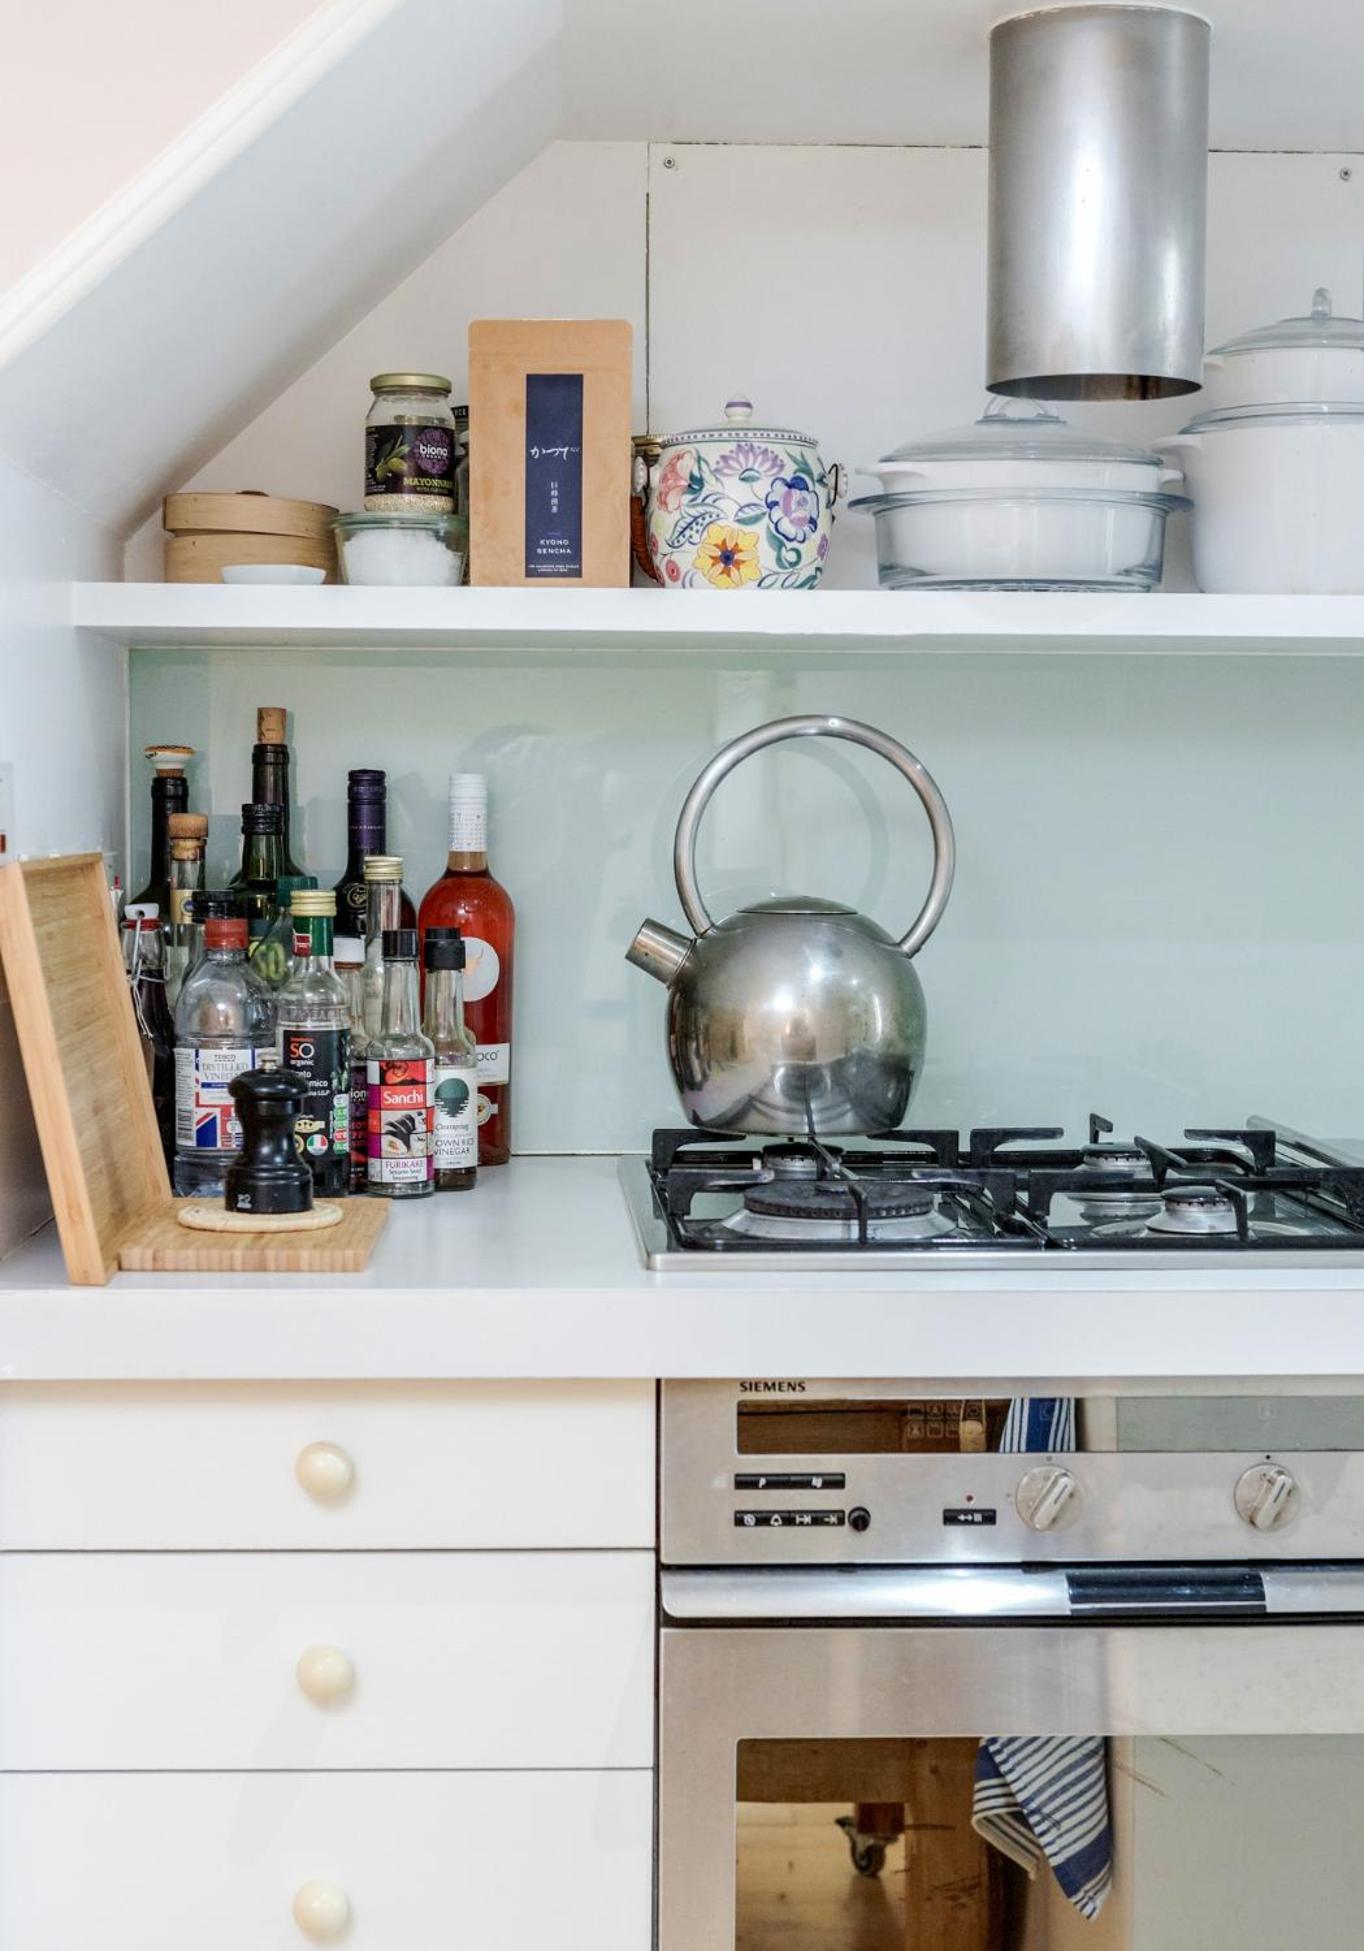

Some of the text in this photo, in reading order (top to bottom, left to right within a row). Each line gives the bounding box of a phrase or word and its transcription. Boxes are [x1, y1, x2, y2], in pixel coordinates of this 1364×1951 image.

[420, 443, 448, 456] biona
[290, 1042, 315, 1059] SO
[383, 1089, 424, 1105] Sanchi
[739, 1381, 806, 1393] SIEMENS
